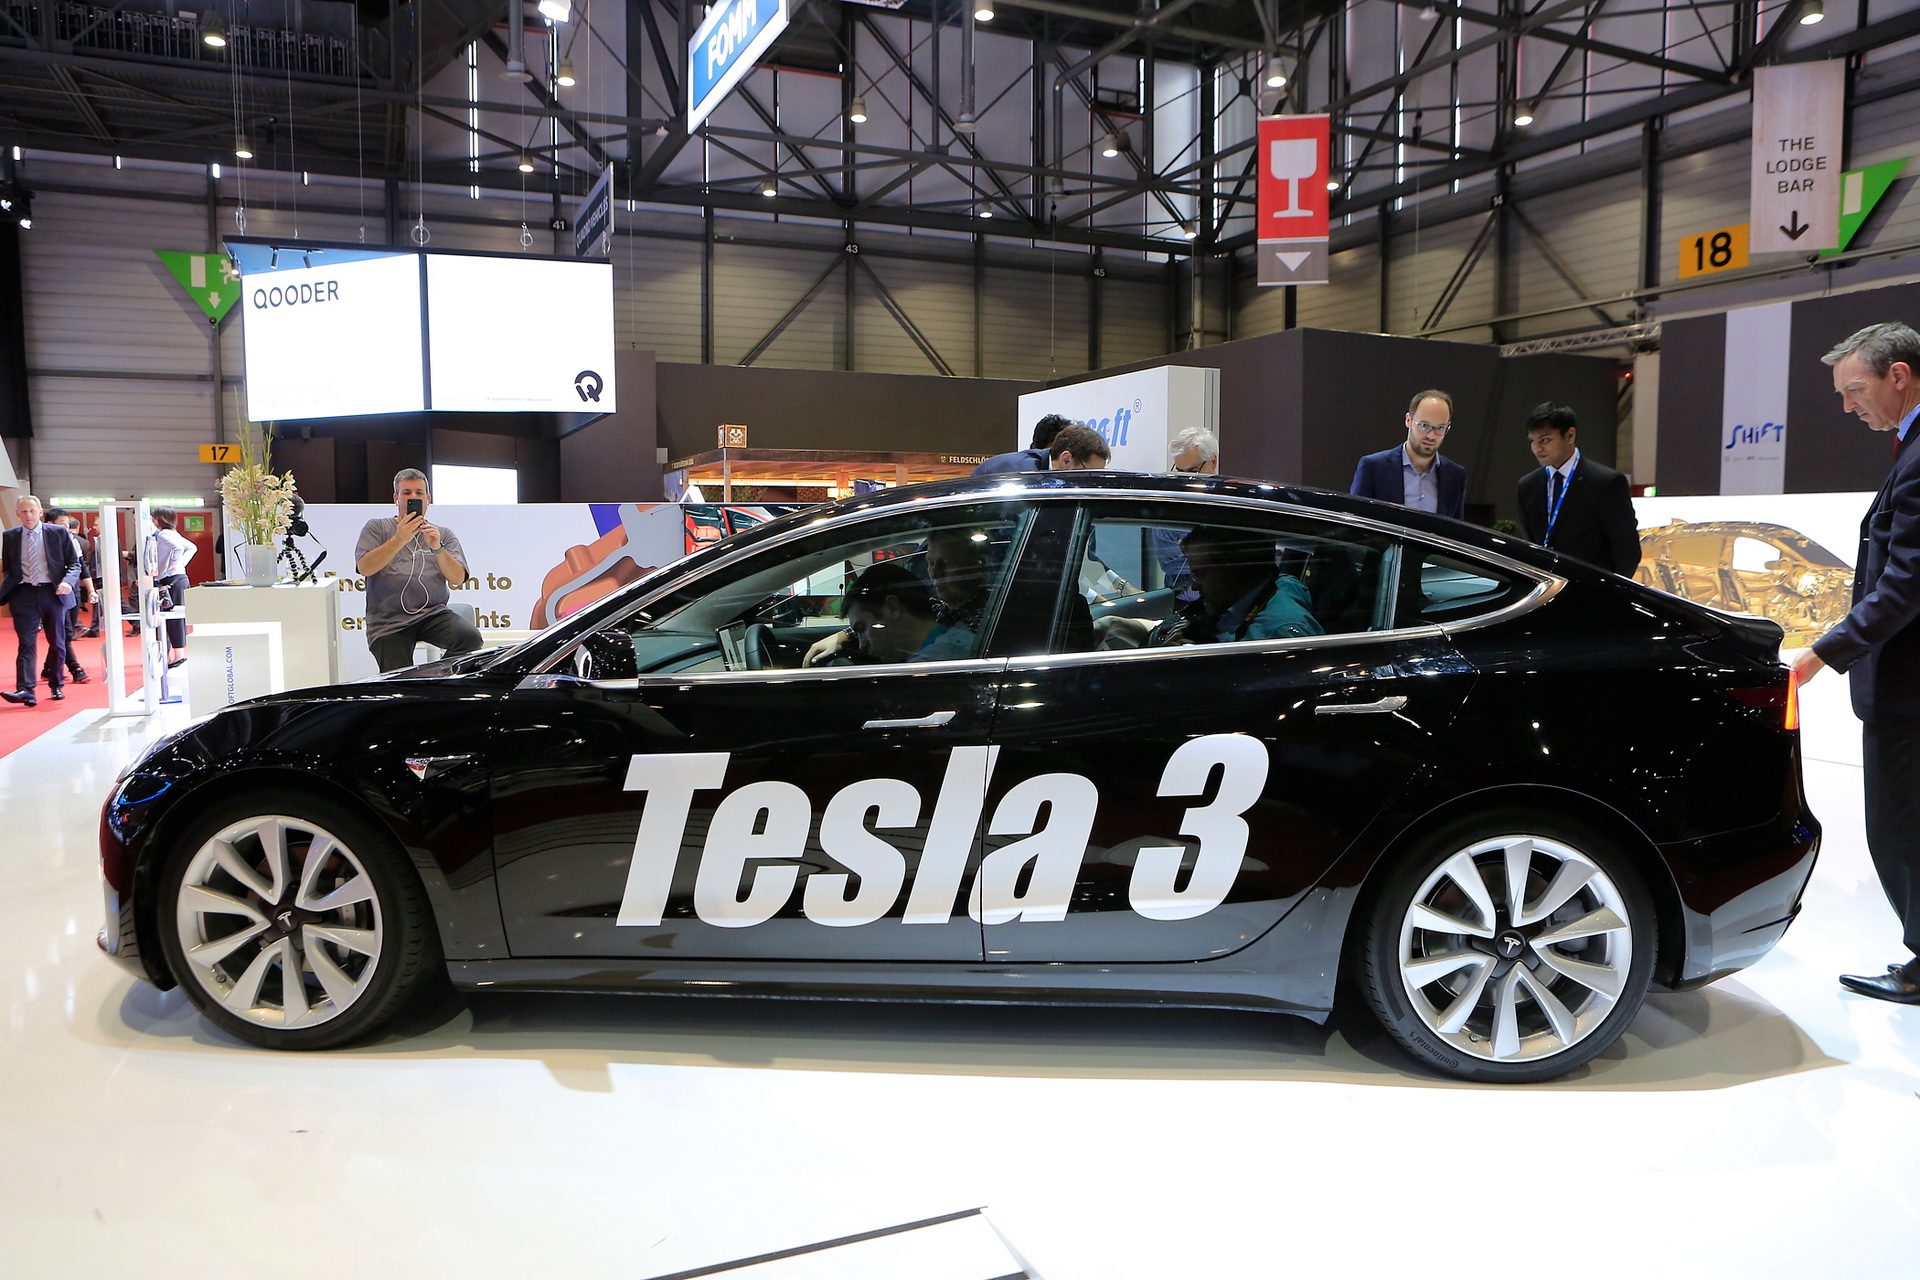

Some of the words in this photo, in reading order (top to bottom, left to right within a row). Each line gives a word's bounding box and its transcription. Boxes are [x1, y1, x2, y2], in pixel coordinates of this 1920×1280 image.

[1778, 137, 1815, 152] THE
[1766, 157, 1827, 174] LODGE
[1777, 179, 1814, 194] BAR
[552, 220, 565, 230] 41
[845, 244, 858, 254] 43
[1695, 232, 1732, 271] 18
[1094, 268, 1105, 277] 45
[253, 280, 339, 309] QOODER
[211, 446, 229, 461] 17
[949, 455, 989, 464] FELDSCHLÖ
[487, 572, 512, 590] to
[616, 745, 1098, 928] Tesla
[1128, 733, 1269, 921] 3
